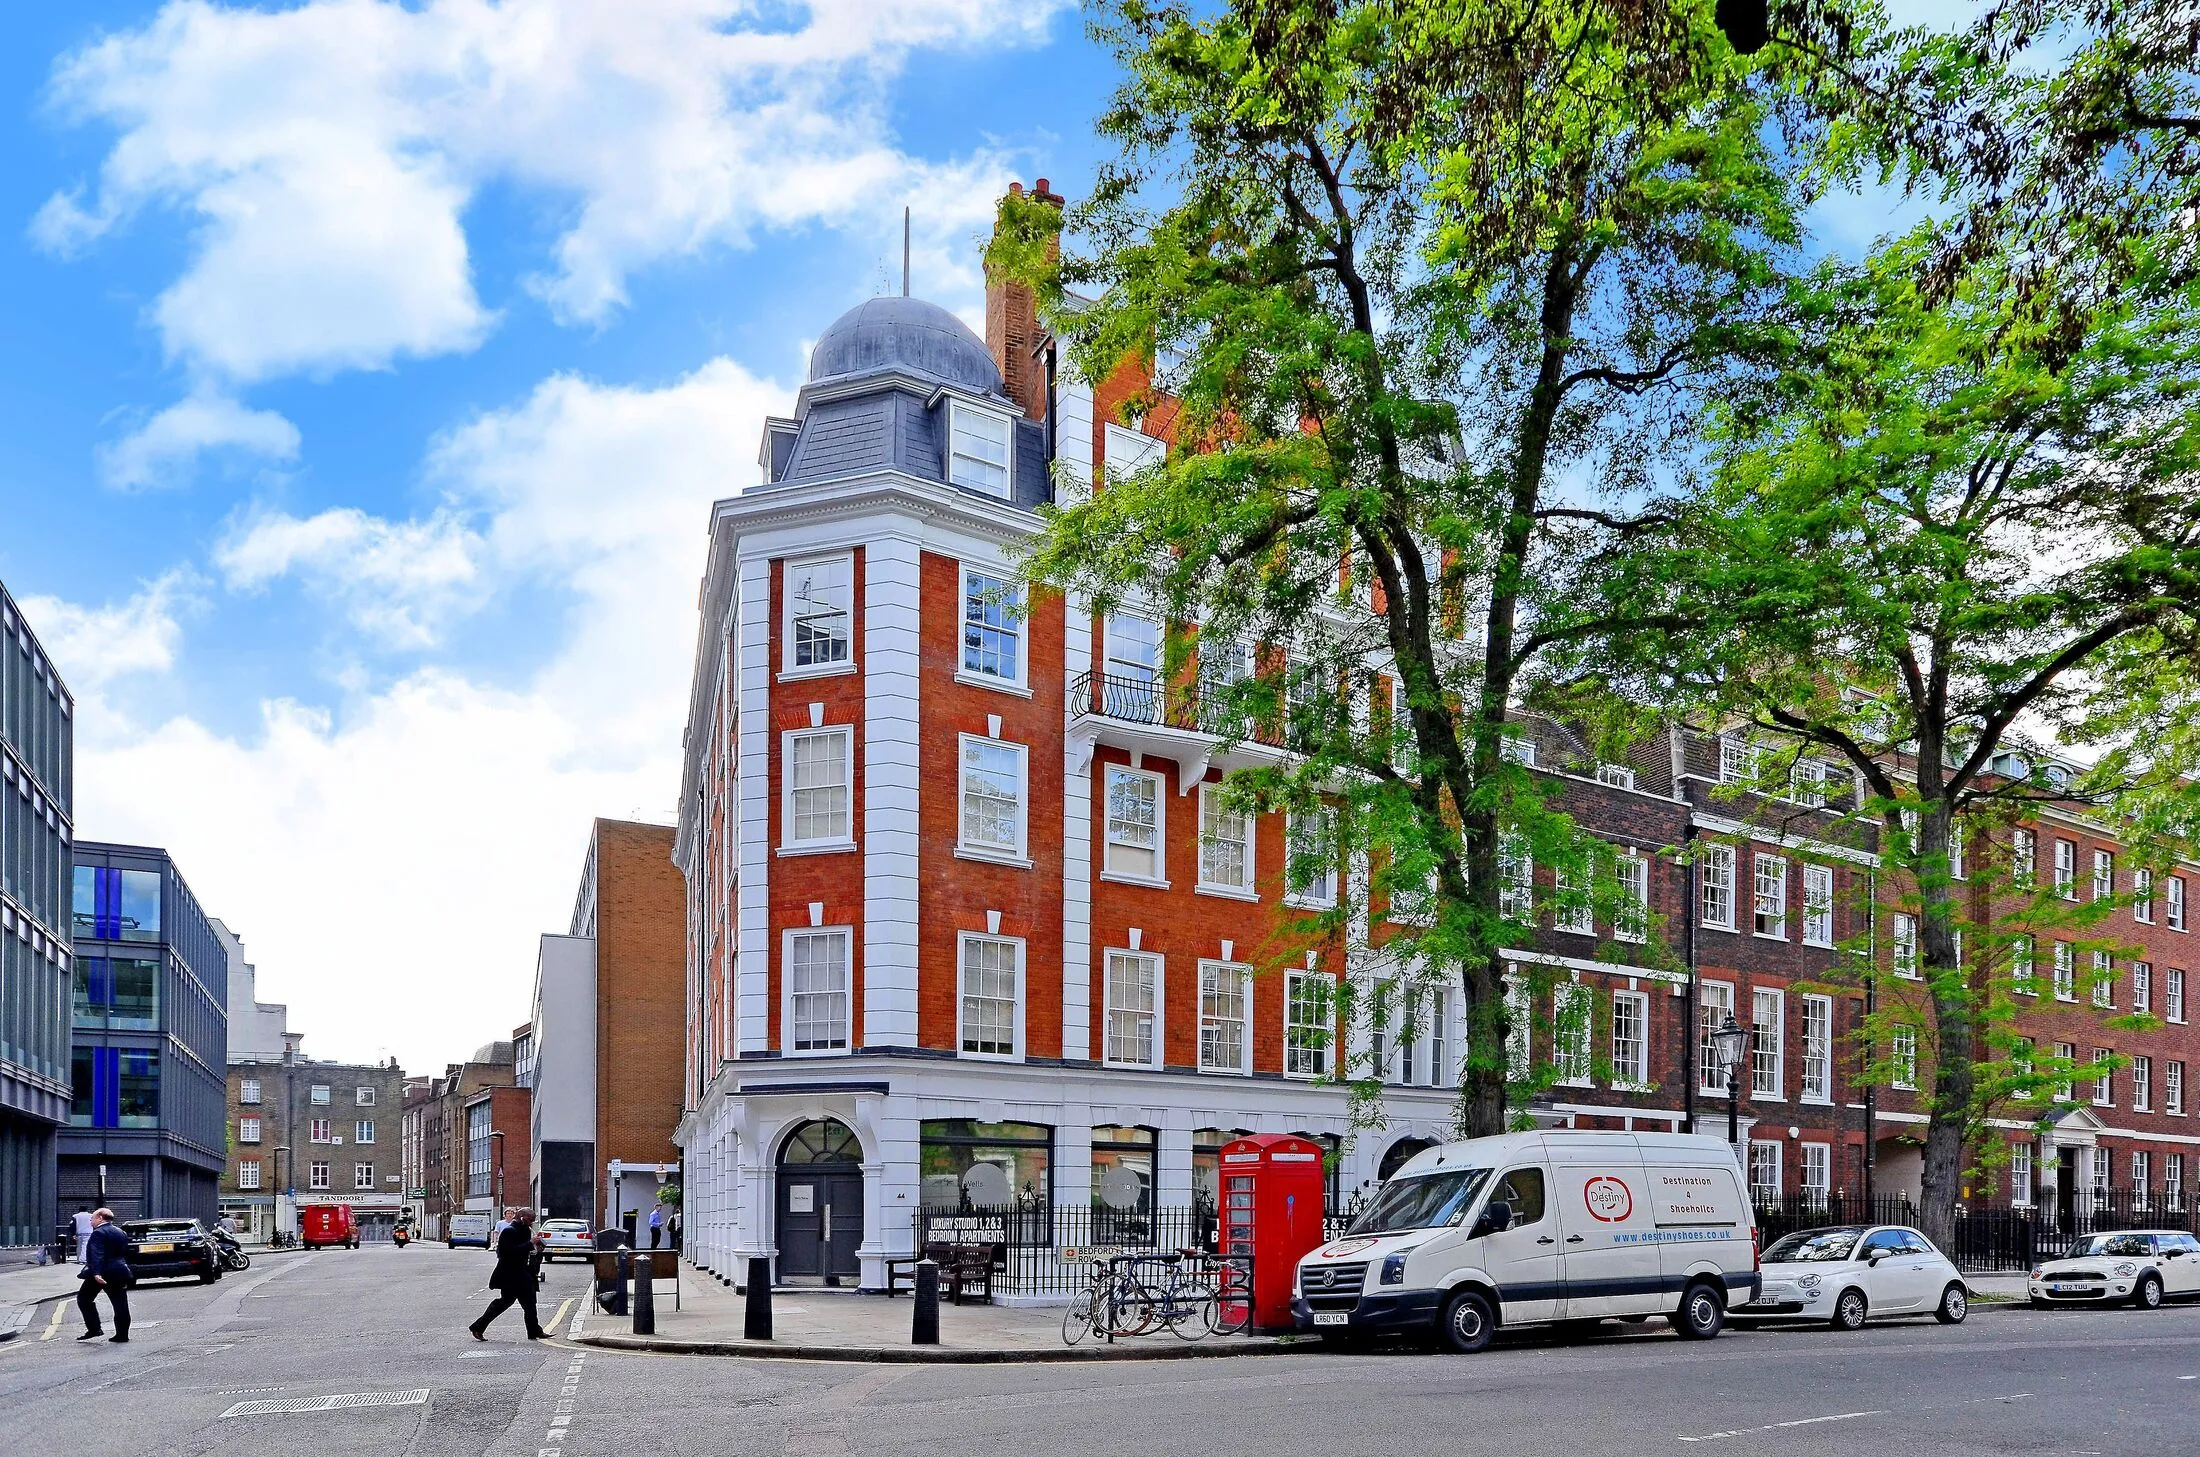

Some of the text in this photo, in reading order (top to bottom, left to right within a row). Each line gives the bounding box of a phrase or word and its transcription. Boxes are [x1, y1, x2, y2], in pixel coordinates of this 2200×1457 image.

[1663, 1177, 1712, 1186] Destination
[1590, 1191, 1625, 1204] Destiny
[1670, 1205, 1715, 1213] Shoeholics
[930, 1218, 955, 1230] LUXURY
[954, 1217, 978, 1230] STUDIO
[985, 1218, 990, 1229] 2
[991, 1217, 998, 1229] &
[996, 1217, 1002, 1229] 3
[1330, 1218, 1339, 1229] &
[928, 1230, 1005, 1243] BEDROOM APARTMENTS
[1613, 1230, 1731, 1243] www.destinyshoes.co.uk
[1078, 1247, 1114, 1255] BEDFORD
